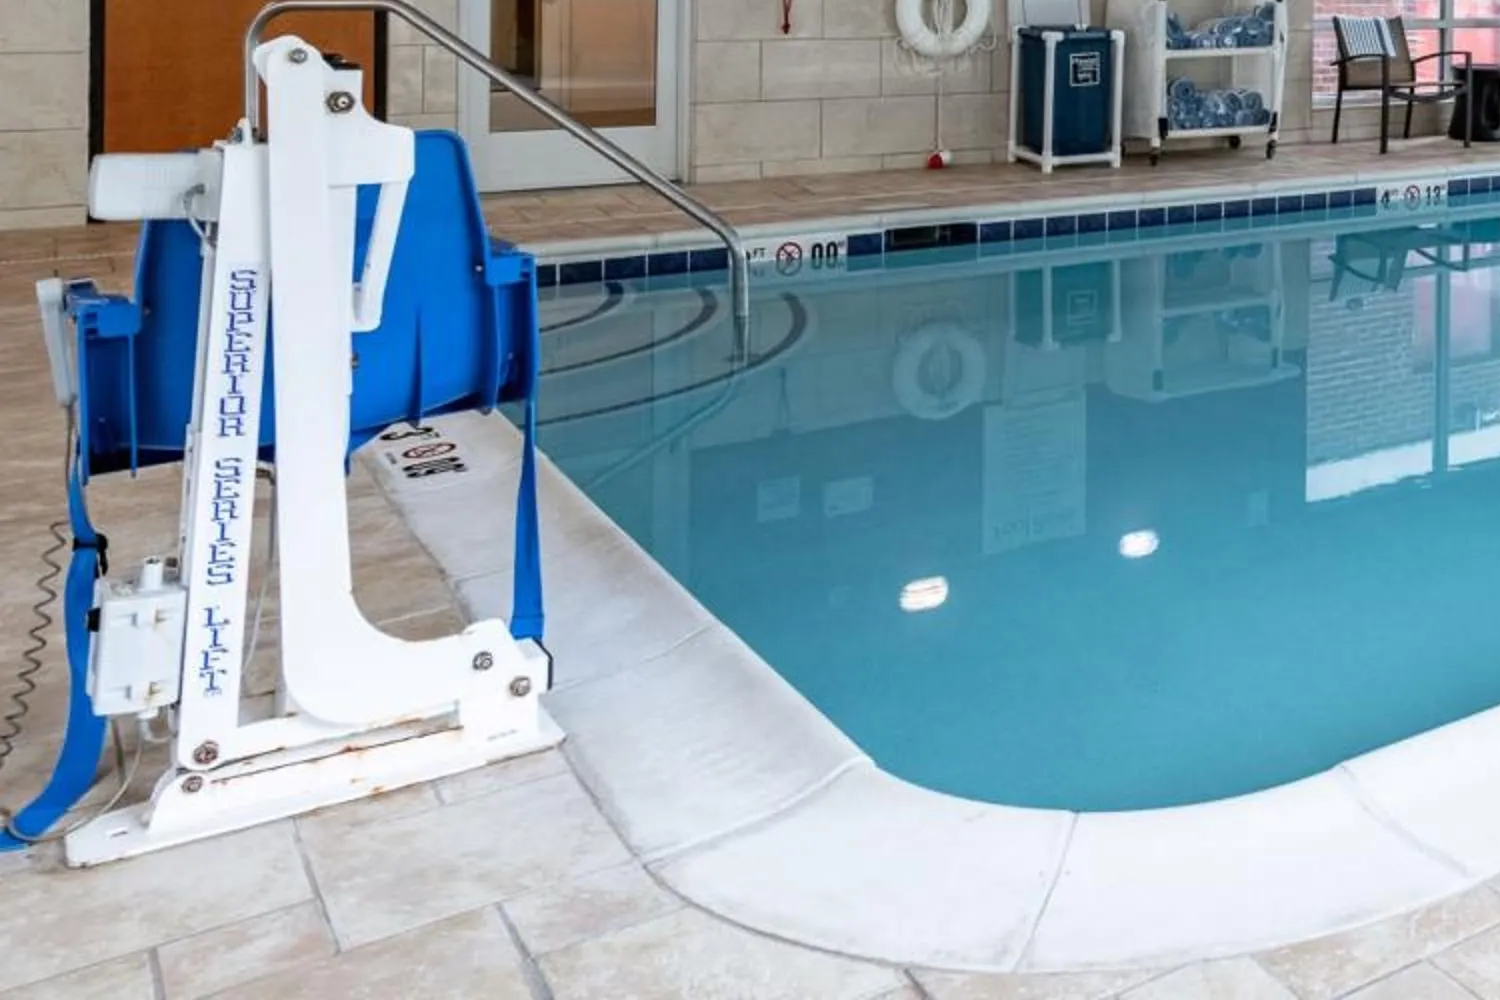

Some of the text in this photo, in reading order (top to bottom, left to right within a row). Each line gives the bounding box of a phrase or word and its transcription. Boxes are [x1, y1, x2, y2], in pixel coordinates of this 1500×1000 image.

[199, 269, 257, 691] SUPERIOR SERIES LIFT
